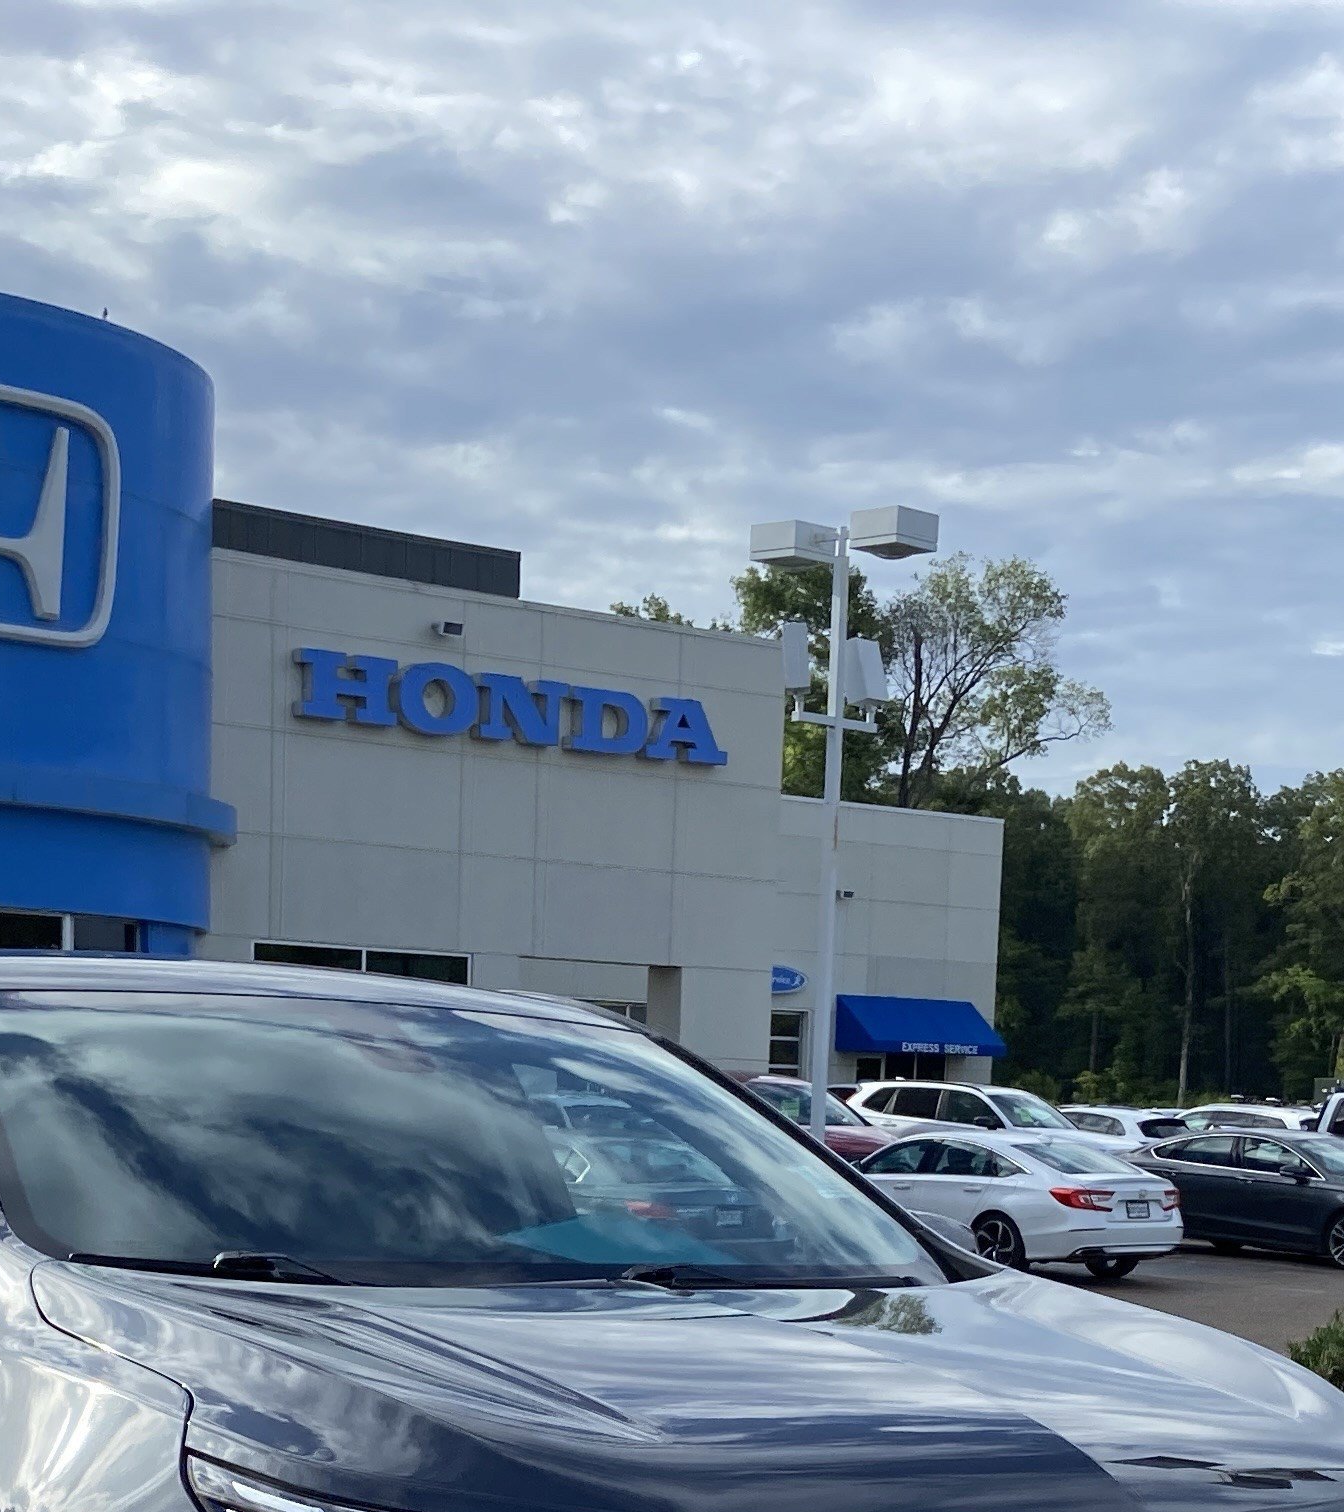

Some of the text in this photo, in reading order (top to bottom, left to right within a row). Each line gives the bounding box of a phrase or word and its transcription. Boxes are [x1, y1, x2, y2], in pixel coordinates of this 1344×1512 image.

[292, 647, 728, 766] HONDA
[901, 1042, 978, 1055] EXPRESS SERVICE
